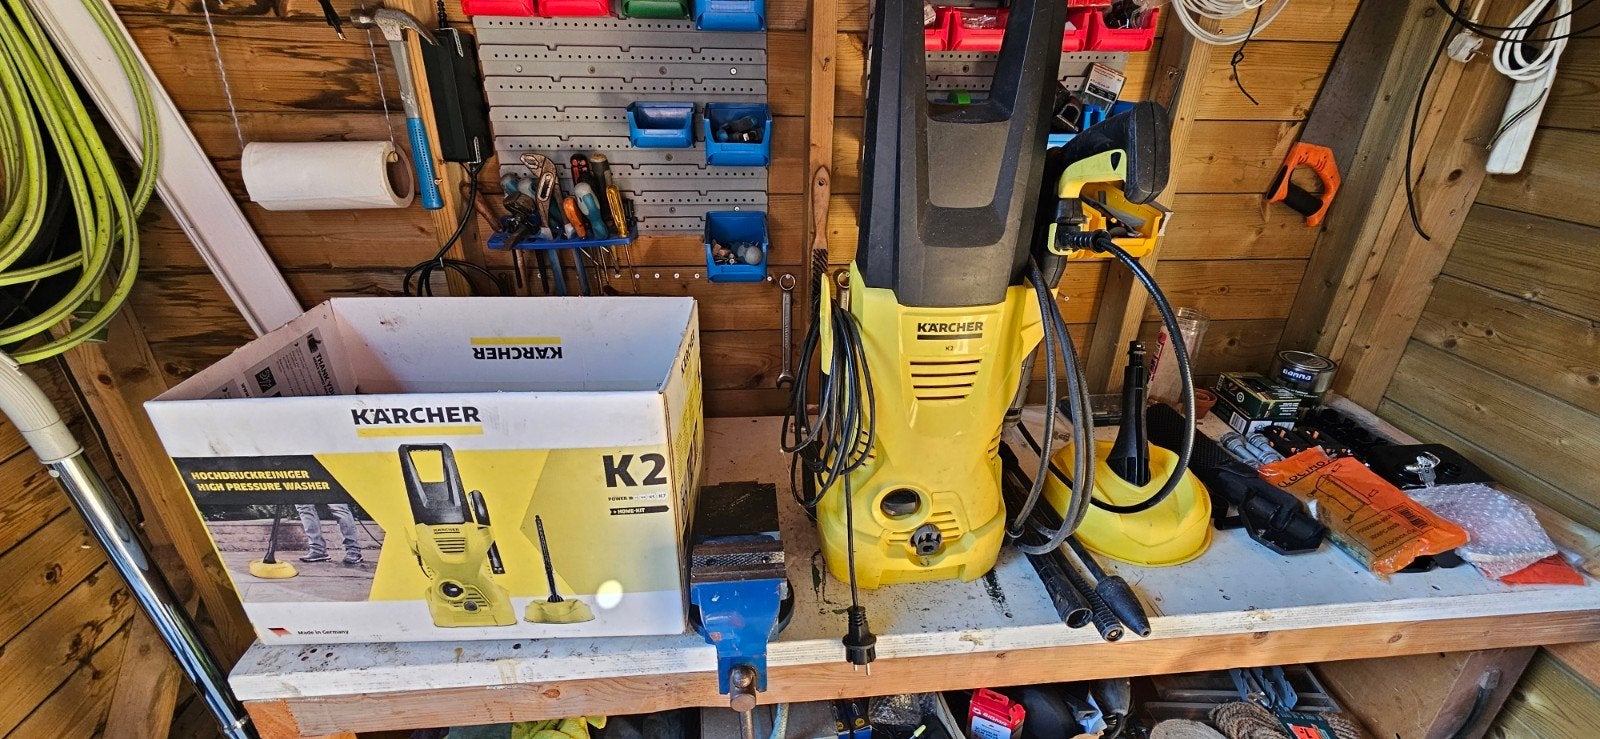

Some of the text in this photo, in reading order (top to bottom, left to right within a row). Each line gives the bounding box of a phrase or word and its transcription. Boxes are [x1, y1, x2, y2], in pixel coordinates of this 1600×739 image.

[917, 321, 984, 333] KÄRCHER
[472, 346, 563, 360] KÄRCHER
[316, 352, 330, 382] THANK
[351, 406, 481, 425] KÄRCHER
[191, 470, 310, 480] HOCHDRUCKREINIGER
[602, 453, 667, 488] K2
[197, 481, 330, 492] HIGH PRESSURE WASHER
